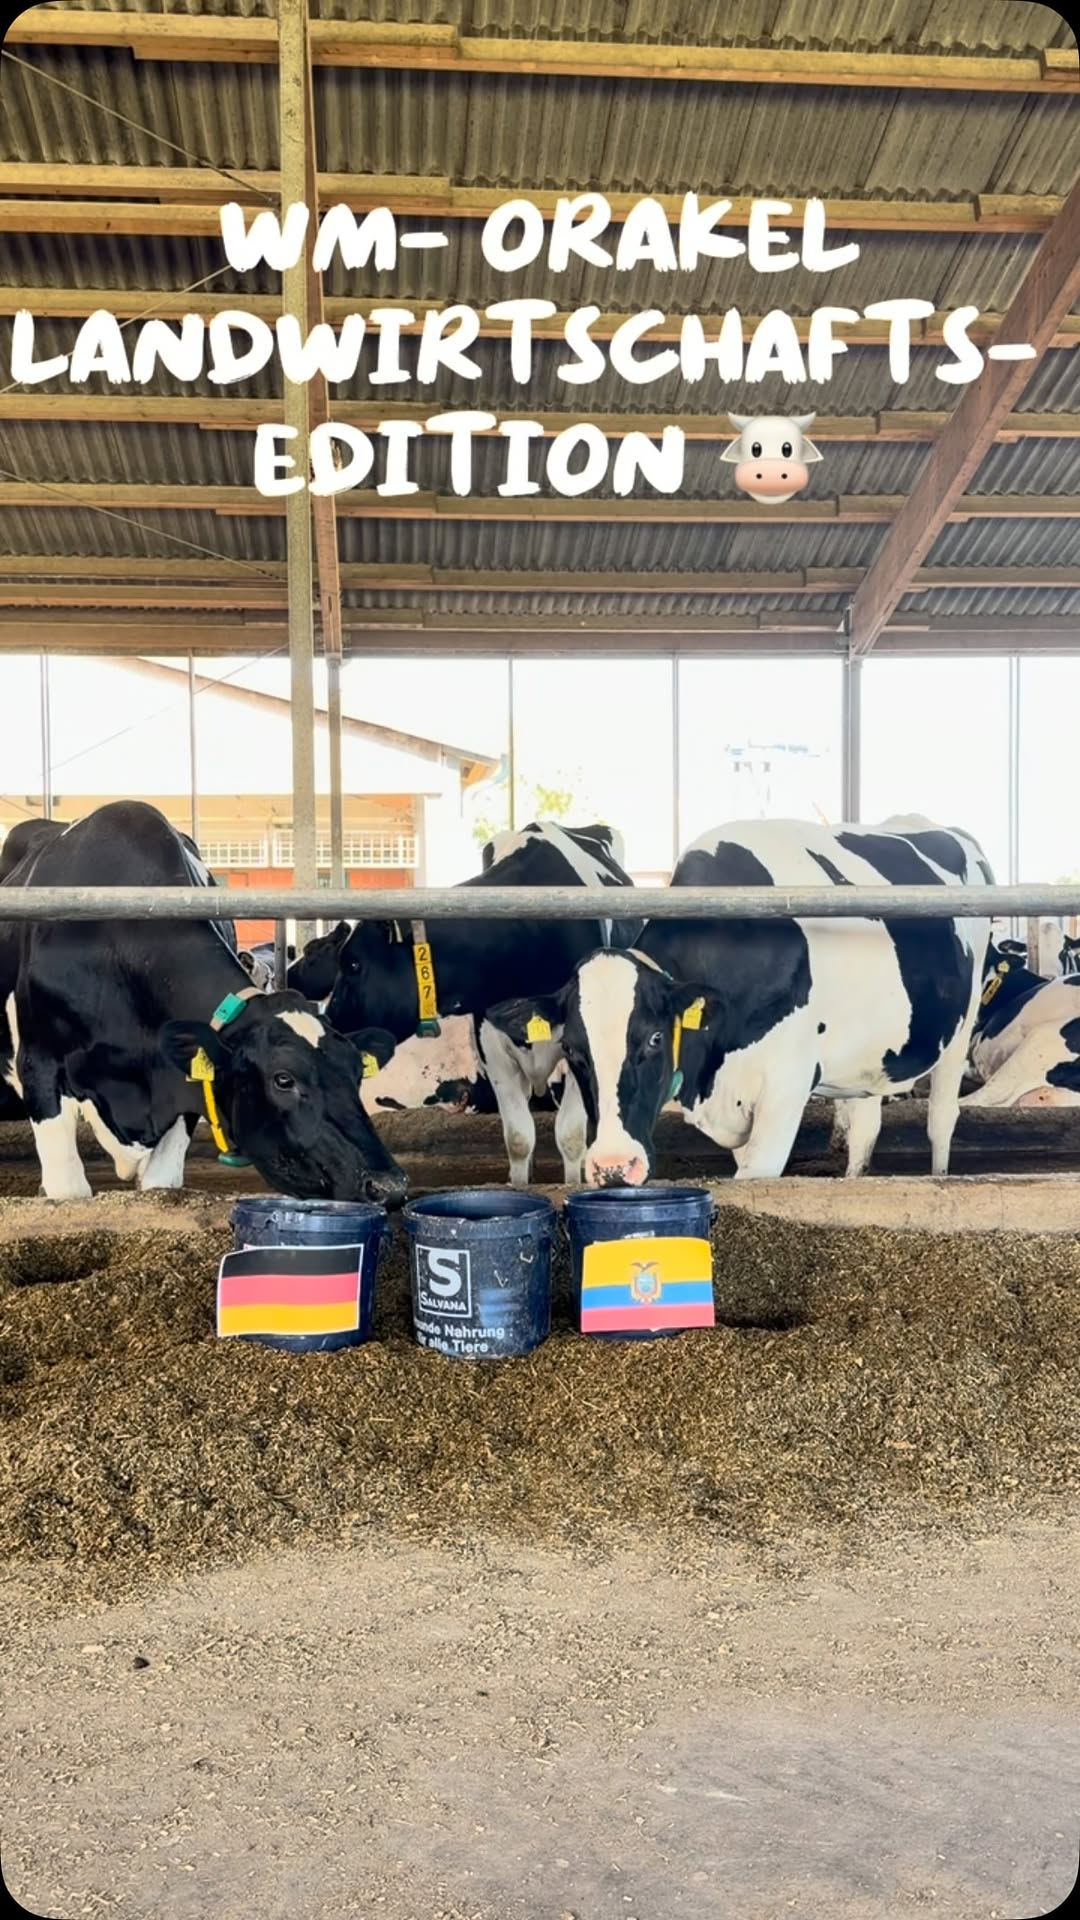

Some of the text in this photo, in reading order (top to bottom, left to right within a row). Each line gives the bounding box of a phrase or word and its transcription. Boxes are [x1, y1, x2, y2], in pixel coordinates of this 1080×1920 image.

[420, 1292, 467, 1311] SALVANA
[444, 1323, 504, 1340] Nahrung
[428, 1337, 449, 1351] alle
[451, 1339, 489, 1353] Tiere
